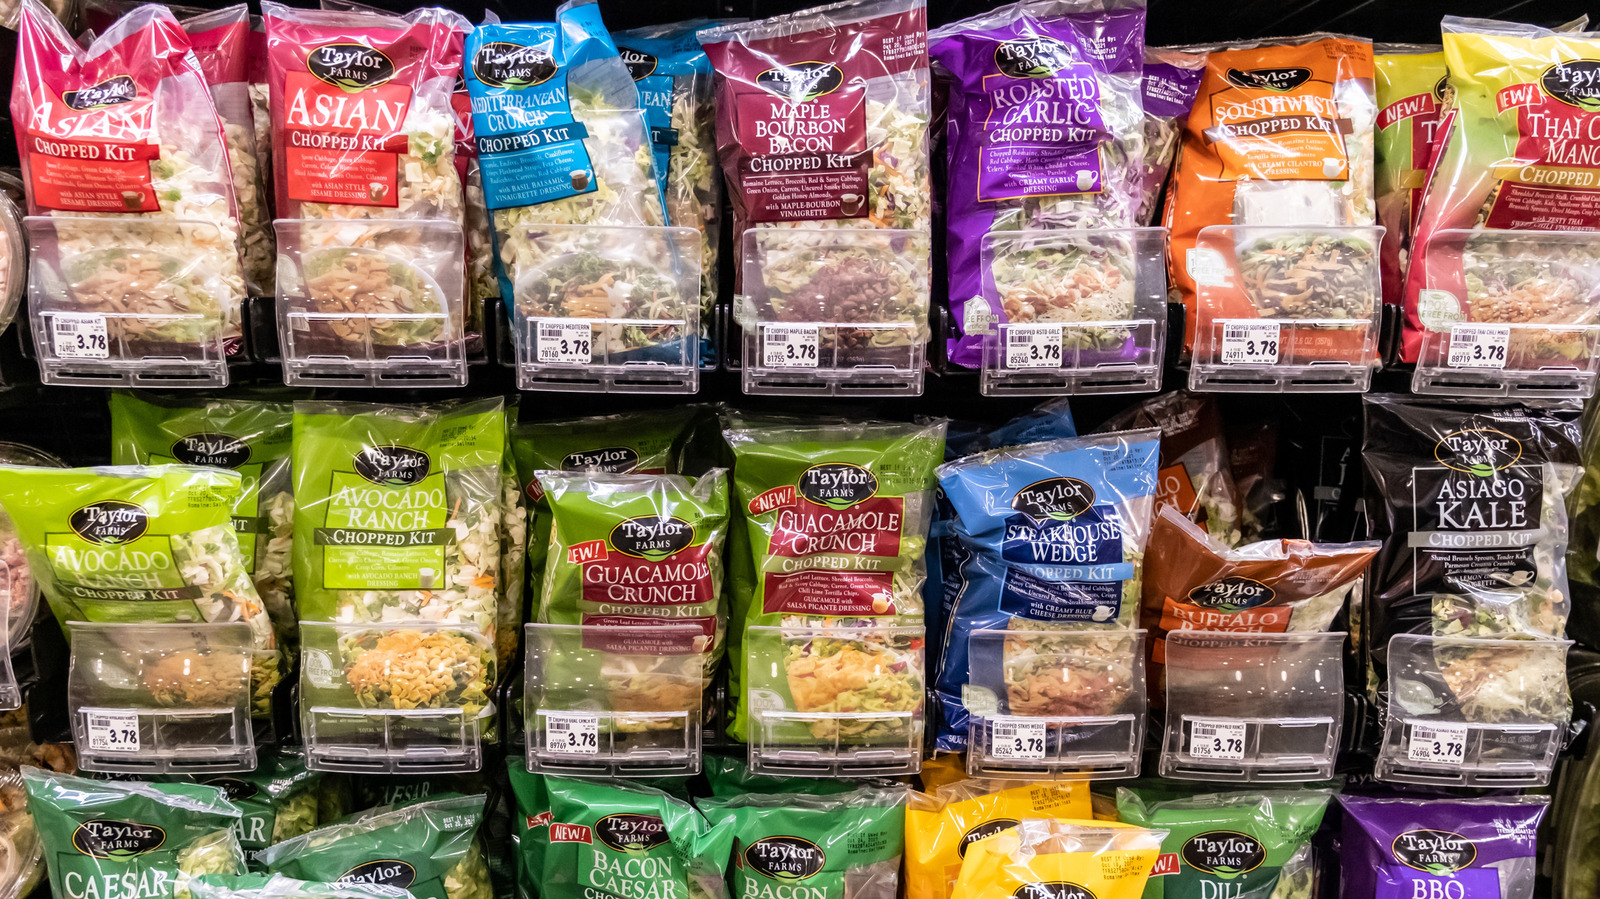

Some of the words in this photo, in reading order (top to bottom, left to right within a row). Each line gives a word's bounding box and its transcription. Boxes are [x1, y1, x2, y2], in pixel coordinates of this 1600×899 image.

[321, 47, 383, 70] Taylor
[481, 48, 545, 72] Taylor
[1000, 41, 1059, 61] Taylor
[330, 67, 368, 81] FARMS
[494, 68, 531, 78] FARMS
[79, 81, 129, 101] Taylor
[471, 86, 567, 114] MEDITERRANEAN
[993, 77, 1096, 109] ROASTED
[1573, 88, 1600, 97] FARM
[287, 88, 404, 132] ASIAN
[771, 104, 830, 119] MAPLE
[1003, 101, 1092, 125] GARLIC
[1216, 95, 1334, 121] SOUTHWEST
[1386, 96, 1427, 124] NEW!
[29, 101, 158, 140] ASIAN
[488, 109, 546, 132] CRUNCH
[756, 119, 846, 138] BOURBON
[1225, 118, 1300, 137] CHOPPED
[1304, 116, 1333, 131] KIT
[1527, 113, 1580, 139] THAI
[292, 131, 358, 151] CHOPPED
[361, 136, 388, 151] KIT
[479, 132, 540, 153] CHOPPED
[542, 127, 569, 143] KIT
[990, 128, 1063, 143] CHOPPED
[1068, 128, 1096, 141] KIT
[35, 137, 99, 160] CHOPPED
[105, 144, 136, 161] KIT
[769, 136, 833, 154] BACON
[750, 157, 821, 173] CHOPPED
[827, 154, 854, 168] KIT
[1019, 178, 1048, 186] CREAMY
[1049, 176, 1075, 184] GARLIC
[1520, 165, 1594, 187] CHOPPED
[334, 190, 366, 199] DRESSING
[1023, 185, 1057, 193] DRESSING
[780, 209, 827, 217] VINAIGRETTE
[781, 200, 840, 209] MAPLE-BOURBON
[77, 334, 106, 350] 3.78
[560, 339, 589, 355] 3.78
[1246, 340, 1277, 356] 3.78
[541, 350, 558, 358] 78160
[786, 344, 816, 359] 3.78
[1030, 344, 1060, 360] 3.78
[1473, 345, 1505, 360] 3.78
[186, 438, 240, 456] Taylor
[1448, 437, 1509, 455] Taylor
[195, 456, 228, 464] FARMS
[369, 451, 424, 471] Taylor
[571, 450, 627, 467] Taylor
[379, 470, 413, 479] FARMS
[808, 469, 867, 489] Taylor
[332, 486, 443, 509] AVOCADO
[820, 489, 854, 497] FARMS
[1020, 483, 1082, 504] Taylor
[1437, 479, 1525, 499] ASIAGO
[759, 489, 791, 511] NEW!
[1039, 502, 1072, 513] FARMS
[84, 507, 138, 526] Taylor
[347, 508, 429, 530] RANCH
[779, 510, 899, 533] GUACAMOLE
[1436, 500, 1528, 529] KALE
[96, 526, 126, 536] FARMS
[333, 530, 405, 546] CHOPPED
[409, 532, 435, 543] KIT
[622, 522, 684, 541] Taylor
[1007, 521, 1120, 541] STEAKHOUSE
[1429, 533, 1503, 547] CHOPPED
[1507, 532, 1532, 545] KIT
[636, 540, 671, 550] FARMS
[792, 533, 875, 555] CRUNCH
[1031, 542, 1098, 562] WEDGE
[54, 549, 170, 572] AVOCADO
[782, 557, 849, 572] CHOPPED
[854, 557, 881, 570] KIT
[586, 561, 710, 584] GUACAMOLE
[1087, 567, 1114, 580] KIT
[74, 585, 146, 600] CHOPPED
[150, 590, 179, 600] KIT
[608, 584, 696, 603] CRUNCH
[1204, 581, 1265, 597] Taylor
[808, 603, 837, 611] PICANTE
[1211, 596, 1248, 605] FARMS
[600, 605, 671, 617] CHOPPED
[676, 605, 703, 616] KIT
[1173, 607, 1278, 627] BUFFALO
[110, 729, 137, 744] 3.78
[568, 732, 596, 747] 3.78
[1014, 738, 1043, 752] 3.78
[1213, 738, 1242, 753] 3.78
[1433, 741, 1462, 757] 3.78
[87, 822, 152, 840] Taylor
[555, 826, 586, 841] NEW!
[608, 817, 664, 833] Taylor
[101, 840, 139, 849] FARMS
[618, 834, 650, 843] FARMS
[1194, 838, 1254, 857] Taylor
[1403, 835, 1464, 854] Taylor
[757, 842, 815, 862] Taylor
[1206, 856, 1241, 865] FARMS
[1419, 854, 1453, 863] FARMS
[593, 850, 673, 879] BACON
[768, 862, 802, 871] FARMS
[65, 871, 168, 899] CAESAR
[589, 868, 677, 899] CAESAR
[745, 876, 828, 899] BACON
[1200, 879, 1245, 899] DILL
[1412, 879, 1465, 899] BBQ
